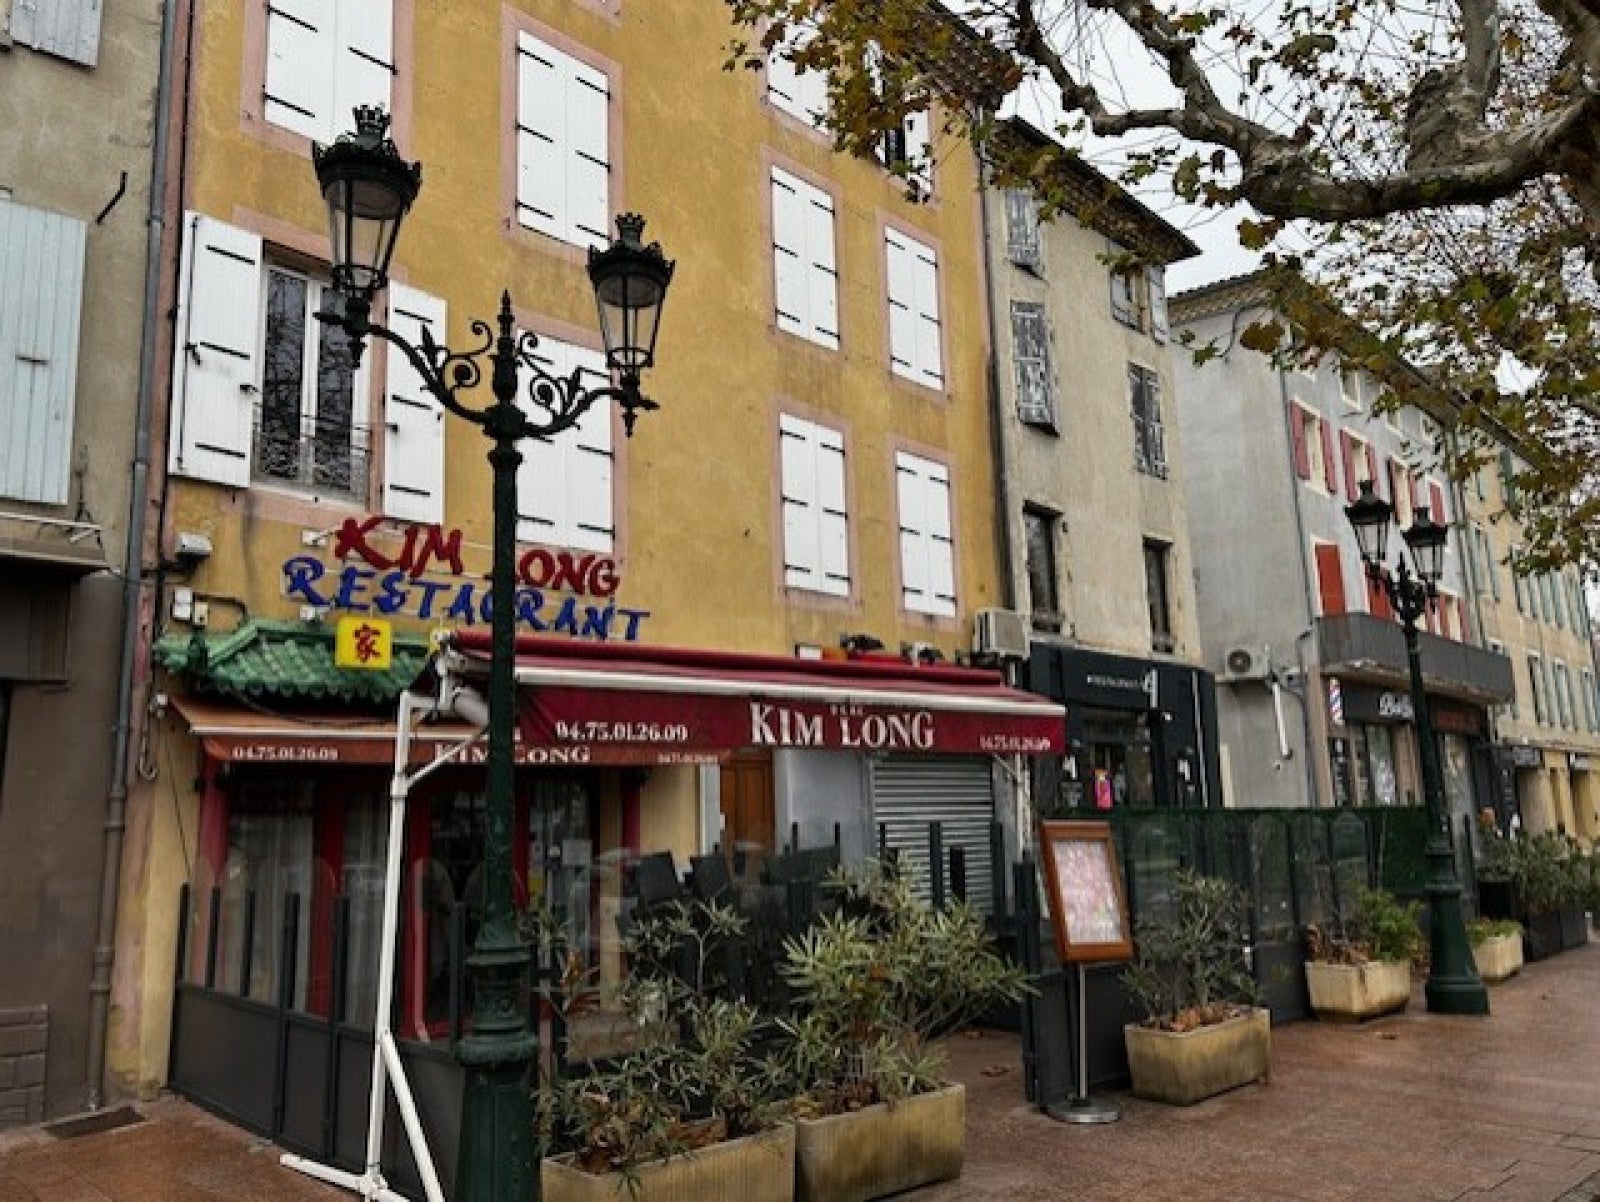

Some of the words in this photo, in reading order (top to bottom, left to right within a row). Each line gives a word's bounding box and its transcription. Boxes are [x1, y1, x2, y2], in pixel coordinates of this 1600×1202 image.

[334, 515, 464, 577] KIM
[554, 719, 689, 741] 04.75.01.26.09
[750, 701, 825, 747] KIM
[840, 711, 936, 748] LONG
